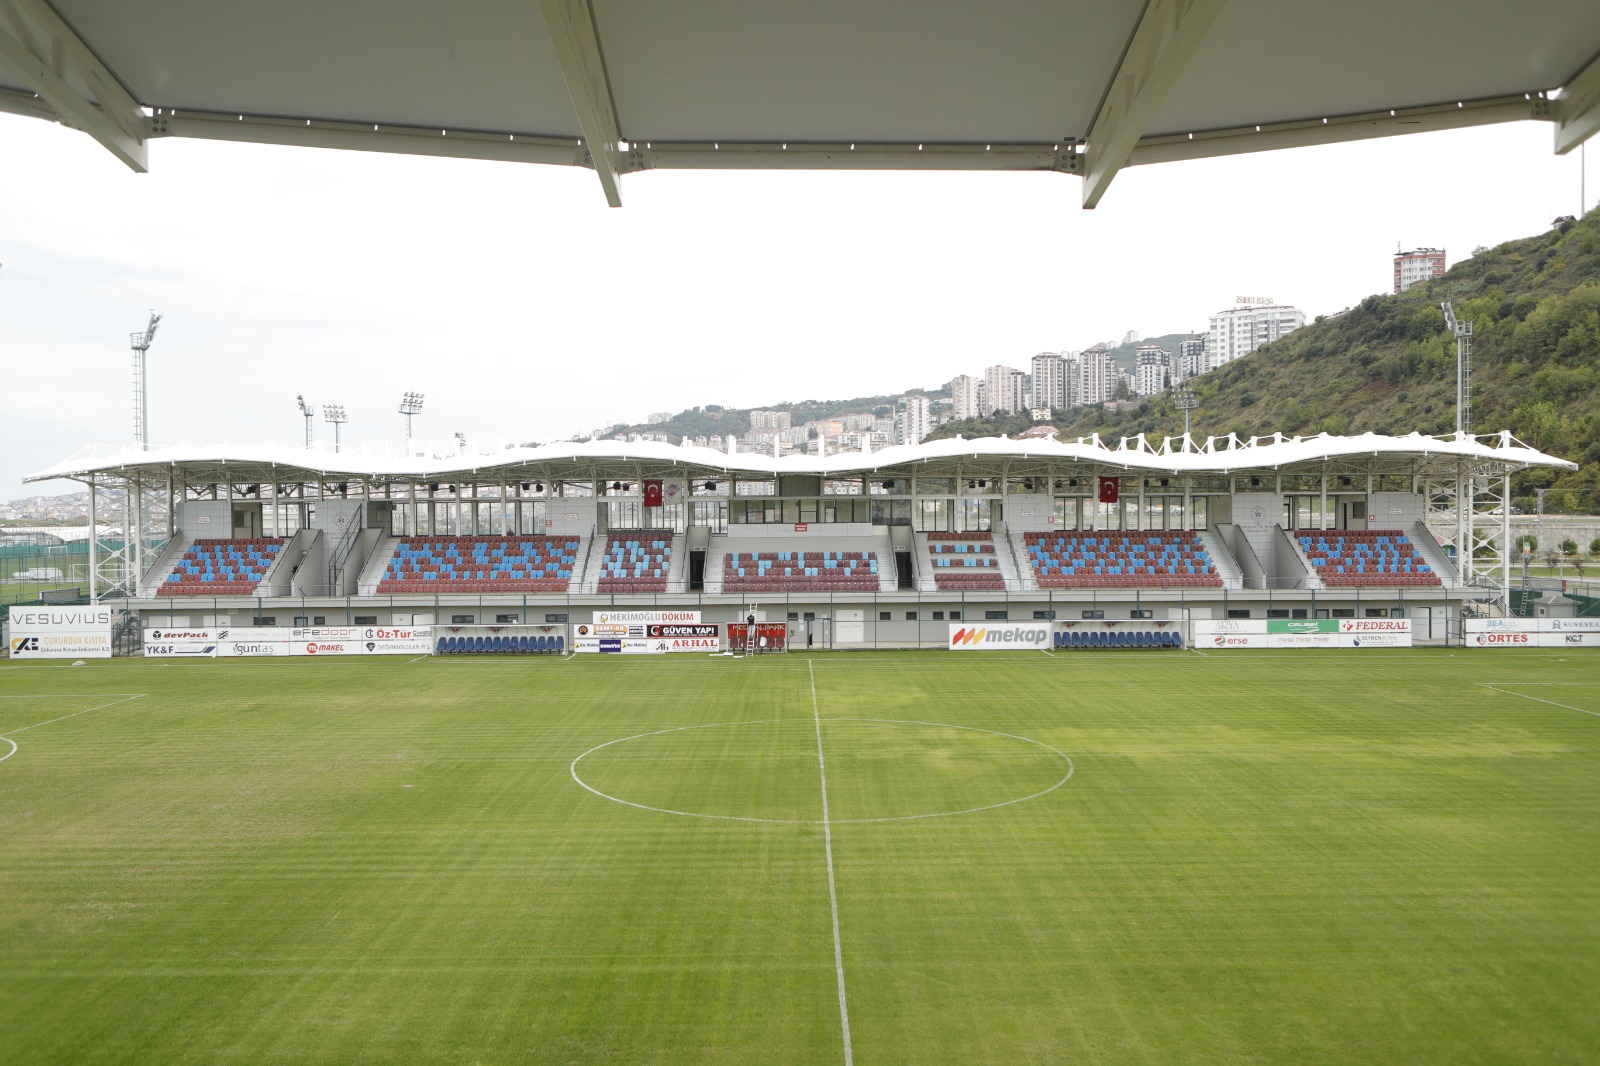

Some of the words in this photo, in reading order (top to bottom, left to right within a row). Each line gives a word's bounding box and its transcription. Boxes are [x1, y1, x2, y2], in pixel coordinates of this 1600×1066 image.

[11, 612, 109, 625] VESUVIUS
[662, 625, 693, 634] GÜVEN
[695, 626, 715, 634] YAPI
[1215, 620, 1240, 630] ARYA
[1355, 621, 1409, 630] FEDERAL
[376, 627, 412, 639] Öz-Tür
[985, 627, 1047, 645] mekap
[44, 635, 82, 647] ÇUKUROVA
[84, 635, 108, 645] KİMYA
[672, 639, 718, 647] ARHAL
[1227, 637, 1248, 645] erse
[1487, 634, 1529, 643] ORTES
[146, 645, 174, 654] YK&F
[318, 644, 345, 652] MAKEL
